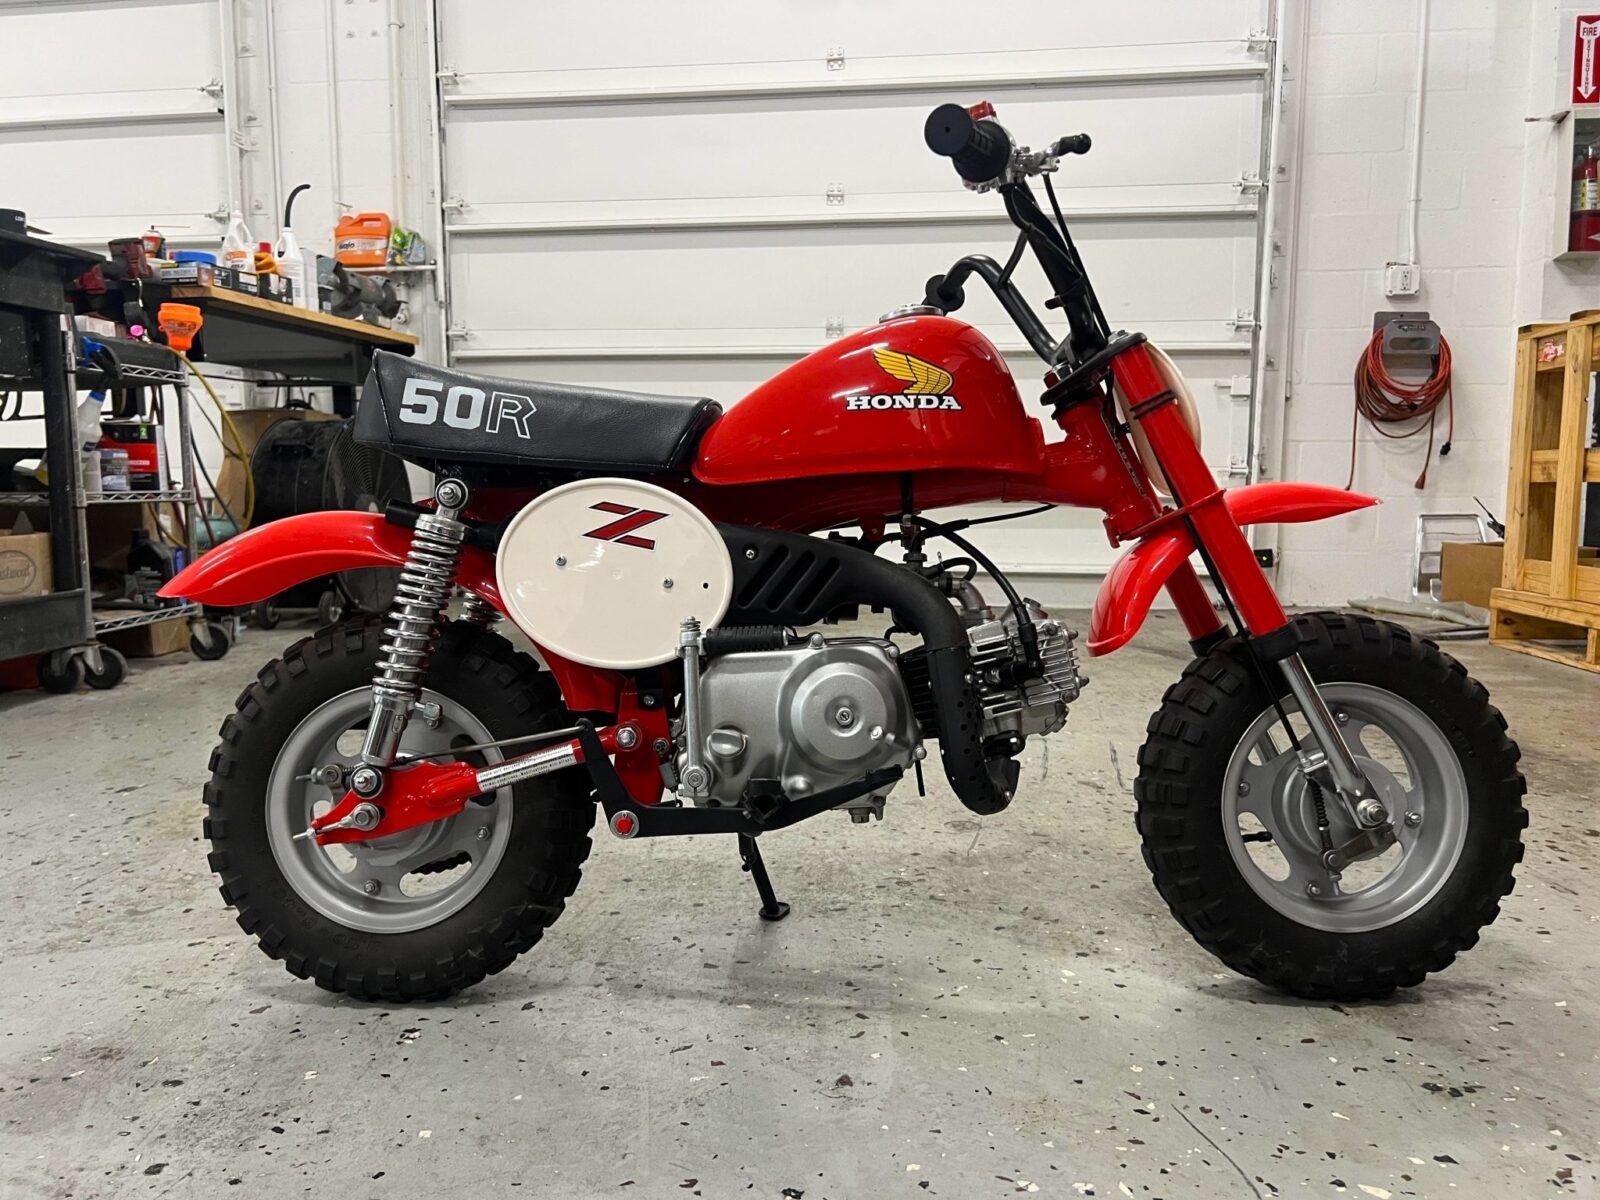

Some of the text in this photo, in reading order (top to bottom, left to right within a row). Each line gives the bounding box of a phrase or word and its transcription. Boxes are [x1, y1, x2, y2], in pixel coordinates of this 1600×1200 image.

[1582, 27, 1597, 36] FIRE
[399, 377, 537, 440] 50R
[846, 394, 962, 411] HONDA
[581, 501, 671, 551] Z
